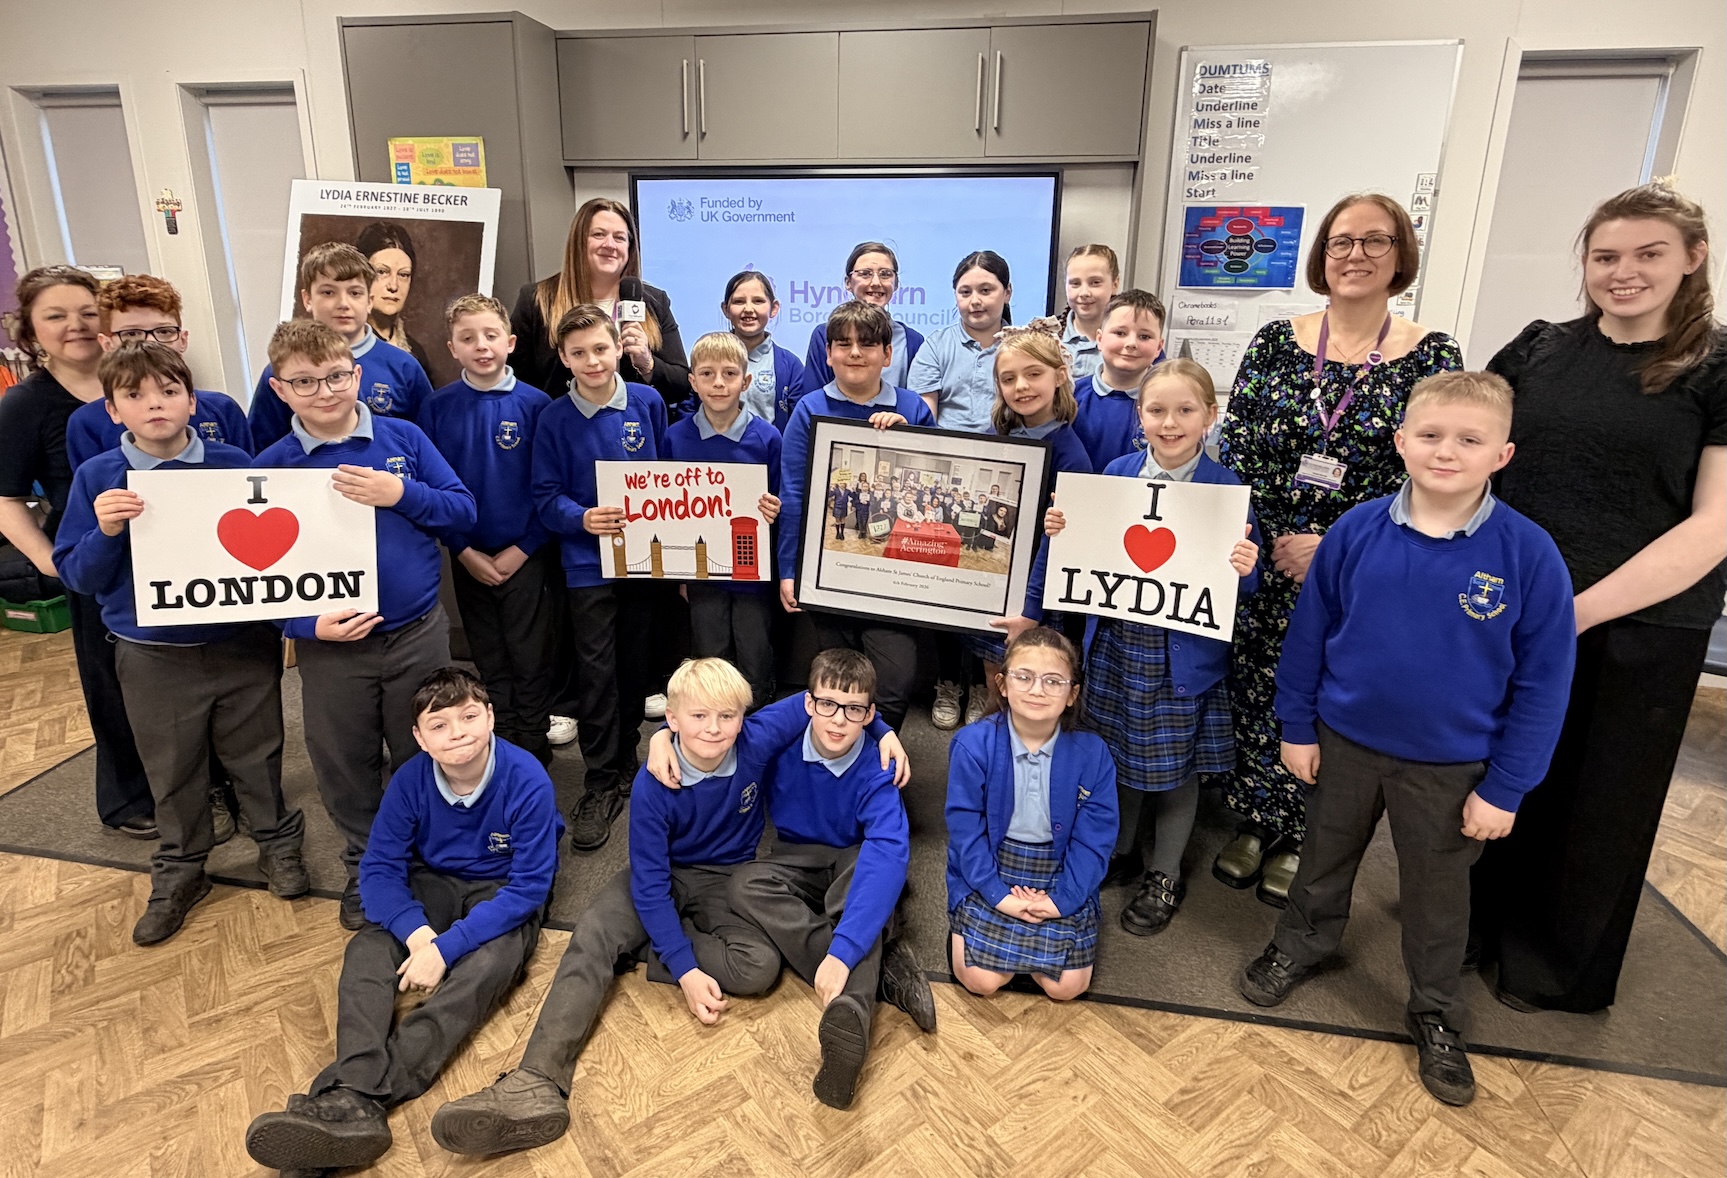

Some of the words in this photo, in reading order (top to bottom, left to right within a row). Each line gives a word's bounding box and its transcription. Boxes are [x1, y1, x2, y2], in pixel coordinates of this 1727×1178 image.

[1198, 84, 1226, 94] Date
[1195, 101, 1258, 112] Underline
[1193, 118, 1222, 129] Miss
[1225, 120, 1233, 129] a
[1237, 117, 1260, 129] line
[1191, 136, 1220, 147] Title
[1190, 152, 1252, 164] Underline
[1188, 170, 1216, 181] Miss
[1220, 172, 1227, 181] a
[1231, 170, 1254, 180] line
[320, 189, 352, 201] LYDIA
[355, 190, 420, 204] ERNESTINE
[423, 193, 468, 206] BECKER
[1186, 187, 1216, 198] Start
[700, 197, 745, 209] Funded
[748, 197, 763, 211] by
[700, 210, 719, 222] UK
[722, 210, 796, 222] Government
[892, 309, 950, 325] ouncil
[624, 470, 671, 490] We're
[674, 467, 702, 488] off
[706, 466, 725, 485] to
[246, 476, 268, 504] I
[624, 487, 733, 523] London!
[1143, 482, 1167, 522] I
[901, 537, 945, 549] #Amazing
[150, 570, 366, 610] LONDON
[1058, 567, 1221, 631] LYDIA
